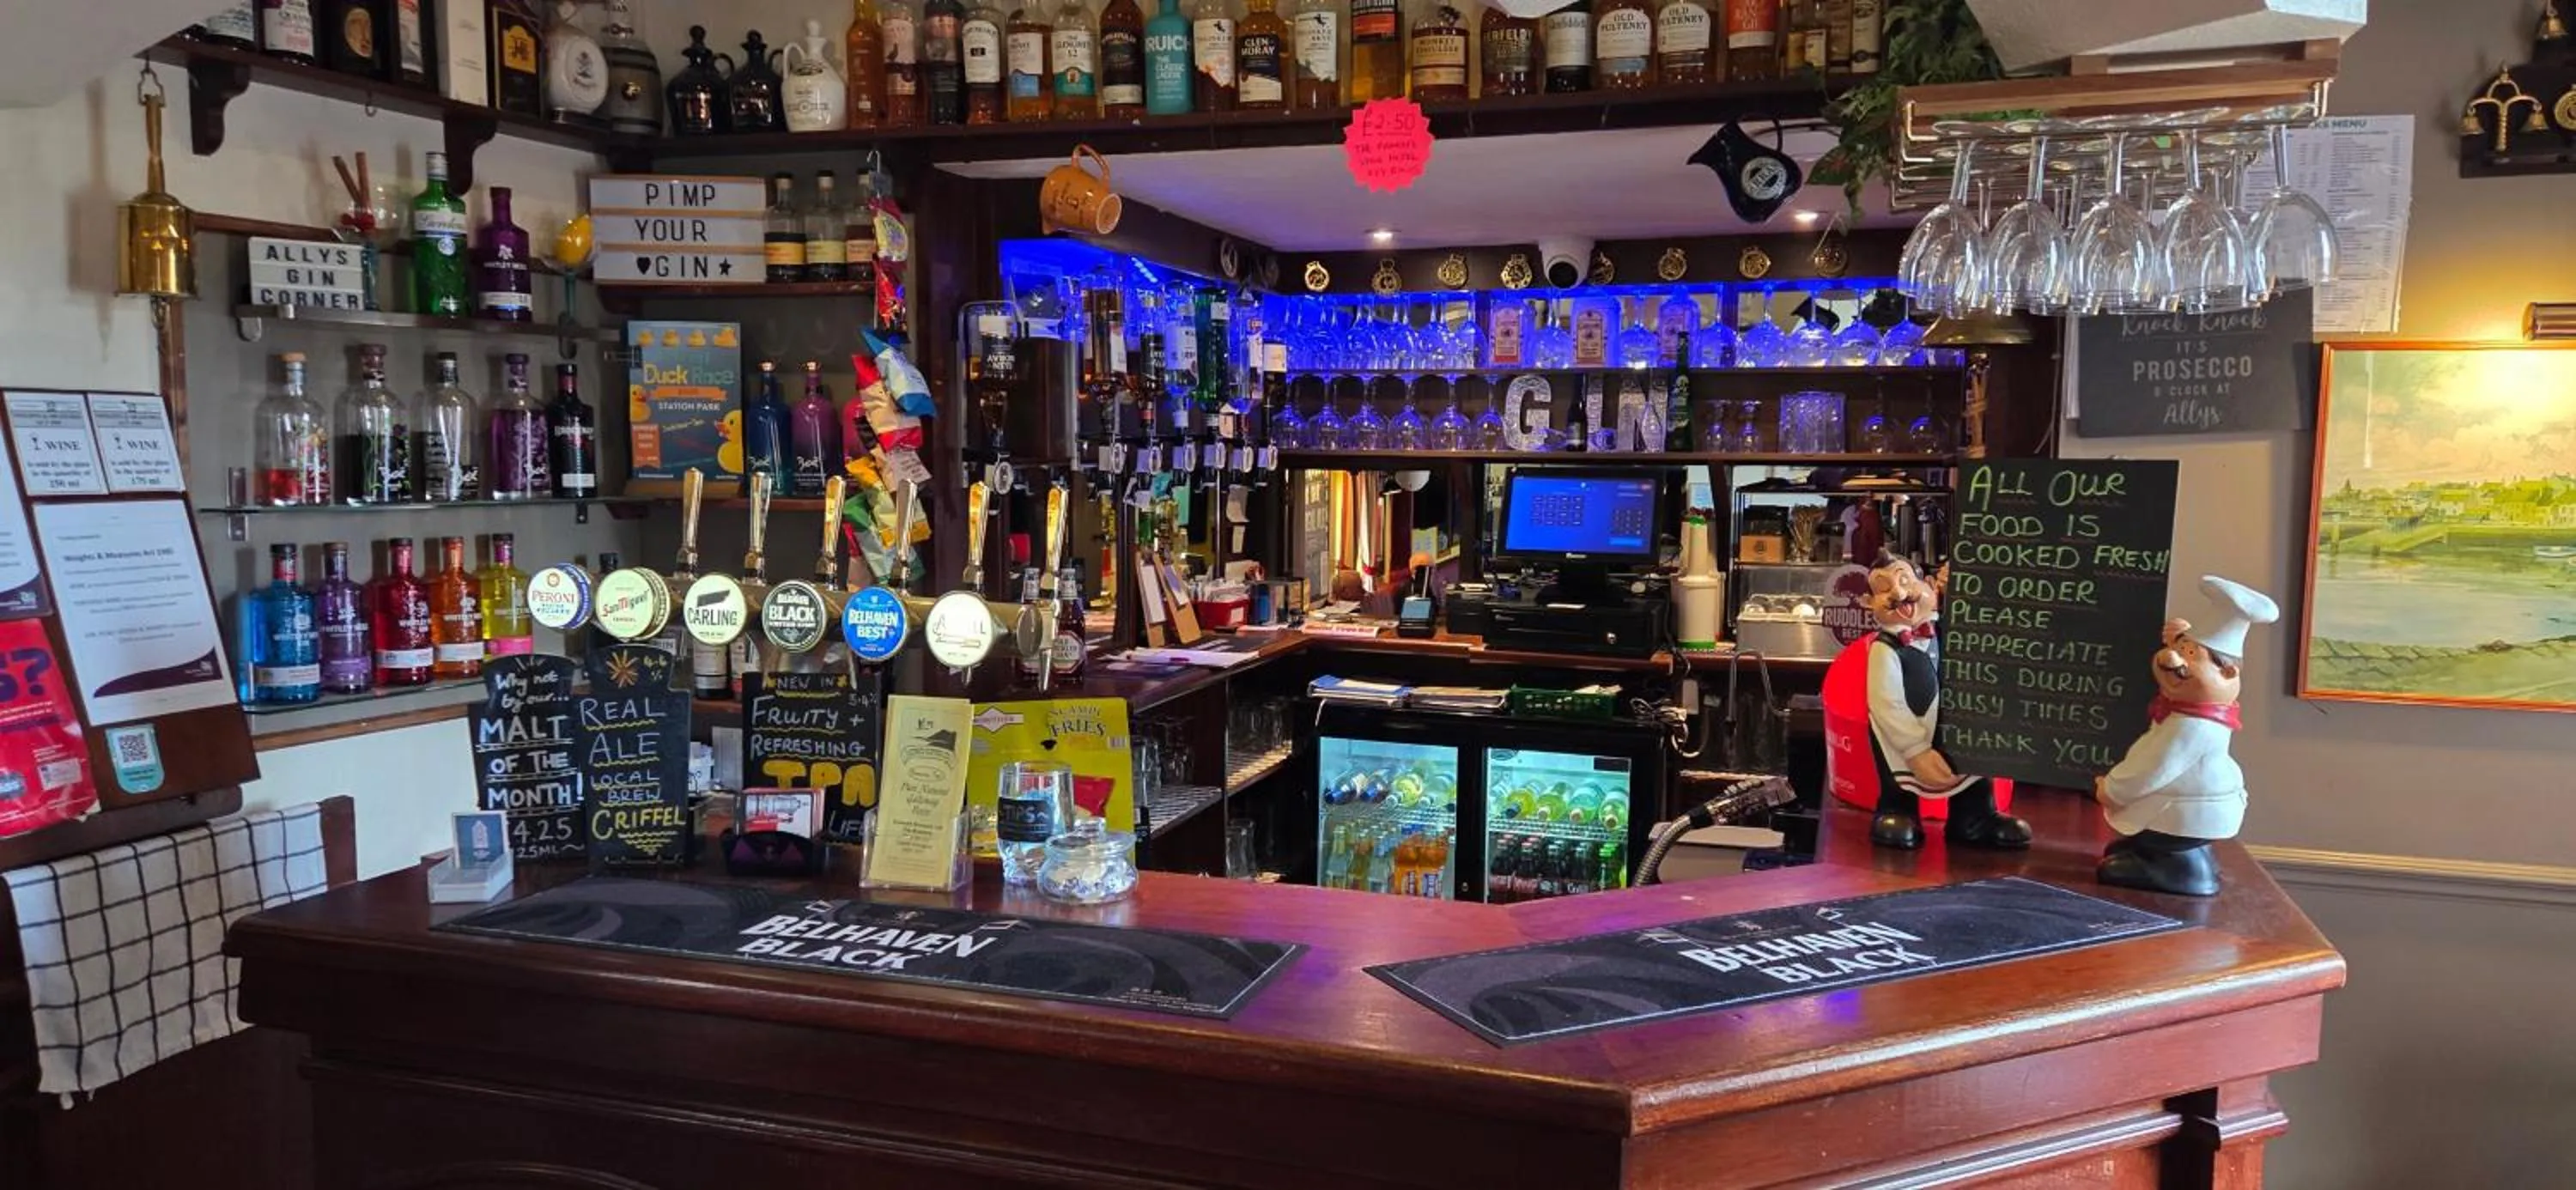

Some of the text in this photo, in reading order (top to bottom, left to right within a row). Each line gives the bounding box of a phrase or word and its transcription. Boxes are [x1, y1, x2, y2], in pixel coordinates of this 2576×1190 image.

[645, 183, 716, 207] PIMP
[635, 219, 708, 242] YOUR
[265, 245, 349, 266] ALLYS
[655, 254, 709, 278] GIN
[286, 269, 336, 287] GIN
[260, 288, 360, 309] CORNER
[2121, 307, 2268, 337] Knock Knock
[644, 363, 735, 386] Duck Race
[2132, 355, 2254, 382] PROSECCO
[2216, 383, 2231, 395] AT
[1503, 373, 1668, 453] GIN
[2163, 399, 2222, 428] Allys
[44, 439, 82, 451] WINE
[126, 439, 161, 450] WINE
[1968, 464, 2127, 511] ALL OUR
[1959, 513, 2100, 537] FOOD IS
[1953, 540, 2170, 574] COOKED FRESH
[532, 590, 575, 604] PERONI
[1951, 572, 2098, 604] TO ORDER
[687, 608, 738, 627] CARLING
[769, 605, 816, 622] BLACK
[848, 608, 899, 627] BELHAVEN
[1951, 599, 2054, 629] PLEASE
[856, 626, 888, 639] BEST
[1946, 630, 2113, 665] APPRECIATE
[495, 670, 559, 697] Why not
[777, 677, 835, 689] NEW IN
[1942, 659, 2126, 697] THIS DURING
[580, 697, 668, 726] REAL
[752, 695, 839, 730] FRUITY
[1939, 687, 2109, 730] BUSY TIMES
[479, 714, 569, 744] MALT
[1049, 719, 1107, 738] FRIES
[588, 732, 660, 765] ALE
[750, 734, 866, 762] REFRESHING
[1937, 723, 2115, 767] THANK YOU
[490, 750, 568, 774] OF THE
[591, 770, 660, 787] LOCAL
[607, 788, 663, 804] BREW
[592, 806, 687, 841] CRIFFEL
[1002, 804, 1036, 822] TIPS
[738, 914, 998, 958] BELHAVEN
[1677, 921, 1923, 973] BELHAVEN
[737, 937, 922, 969] BLACK
[1760, 944, 1937, 983] BLACK
